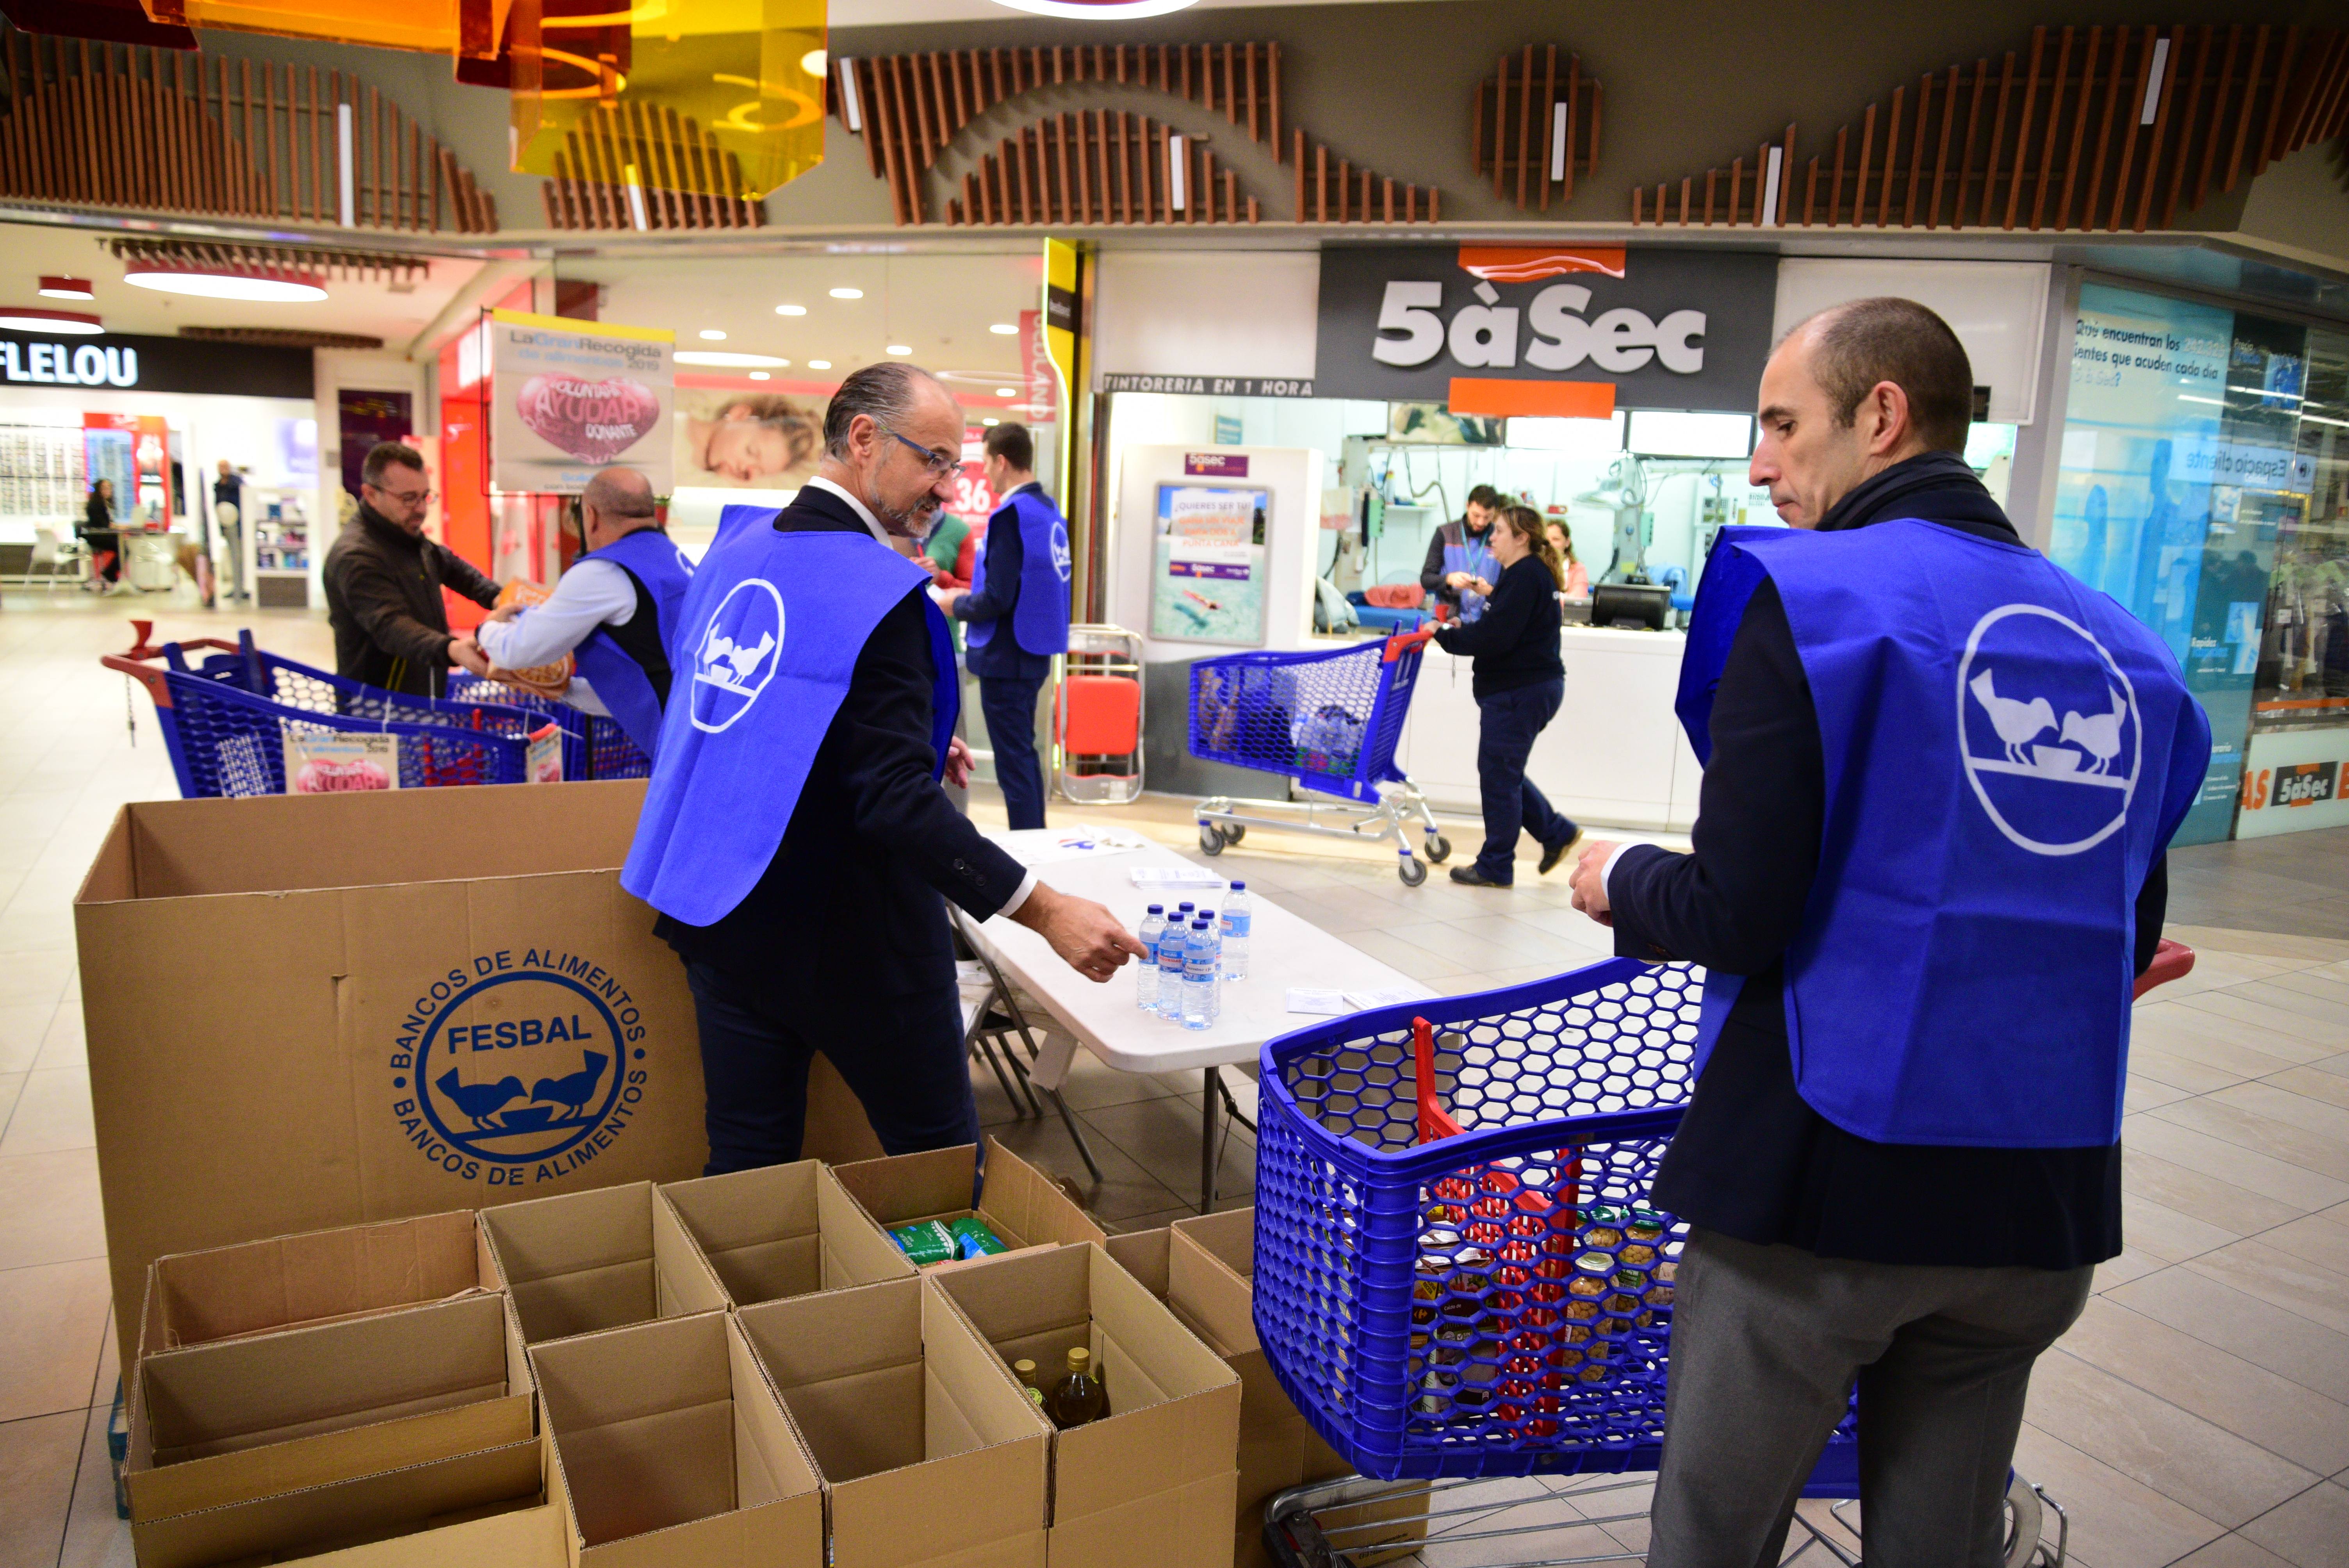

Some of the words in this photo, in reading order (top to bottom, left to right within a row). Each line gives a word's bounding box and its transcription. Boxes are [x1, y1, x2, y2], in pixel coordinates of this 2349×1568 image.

[2103, 327, 2162, 348] encuentran
[2166, 334, 2180, 351] los
[2112, 352, 2132, 368] que
[2135, 355, 2172, 372] acuden
[2176, 360, 2199, 376] cada
[1105, 376, 1204, 393] TINTORERIA
[1214, 379, 1235, 394] EN
[1245, 380, 1251, 394] 1
[1261, 380, 1313, 396] HORA
[535, 387, 641, 425] AYUDAR
[955, 478, 991, 513] 36
[390, 969, 467, 1069] BANCOS
[474, 950, 513, 976] DE
[522, 948, 645, 1042] ALIMENTOS
[448, 1015, 592, 1054] FESBAL
[394, 1099, 479, 1180] BANCOS
[488, 1167, 524, 1185] DE
[536, 1069, 647, 1183] ALIMENTOS
